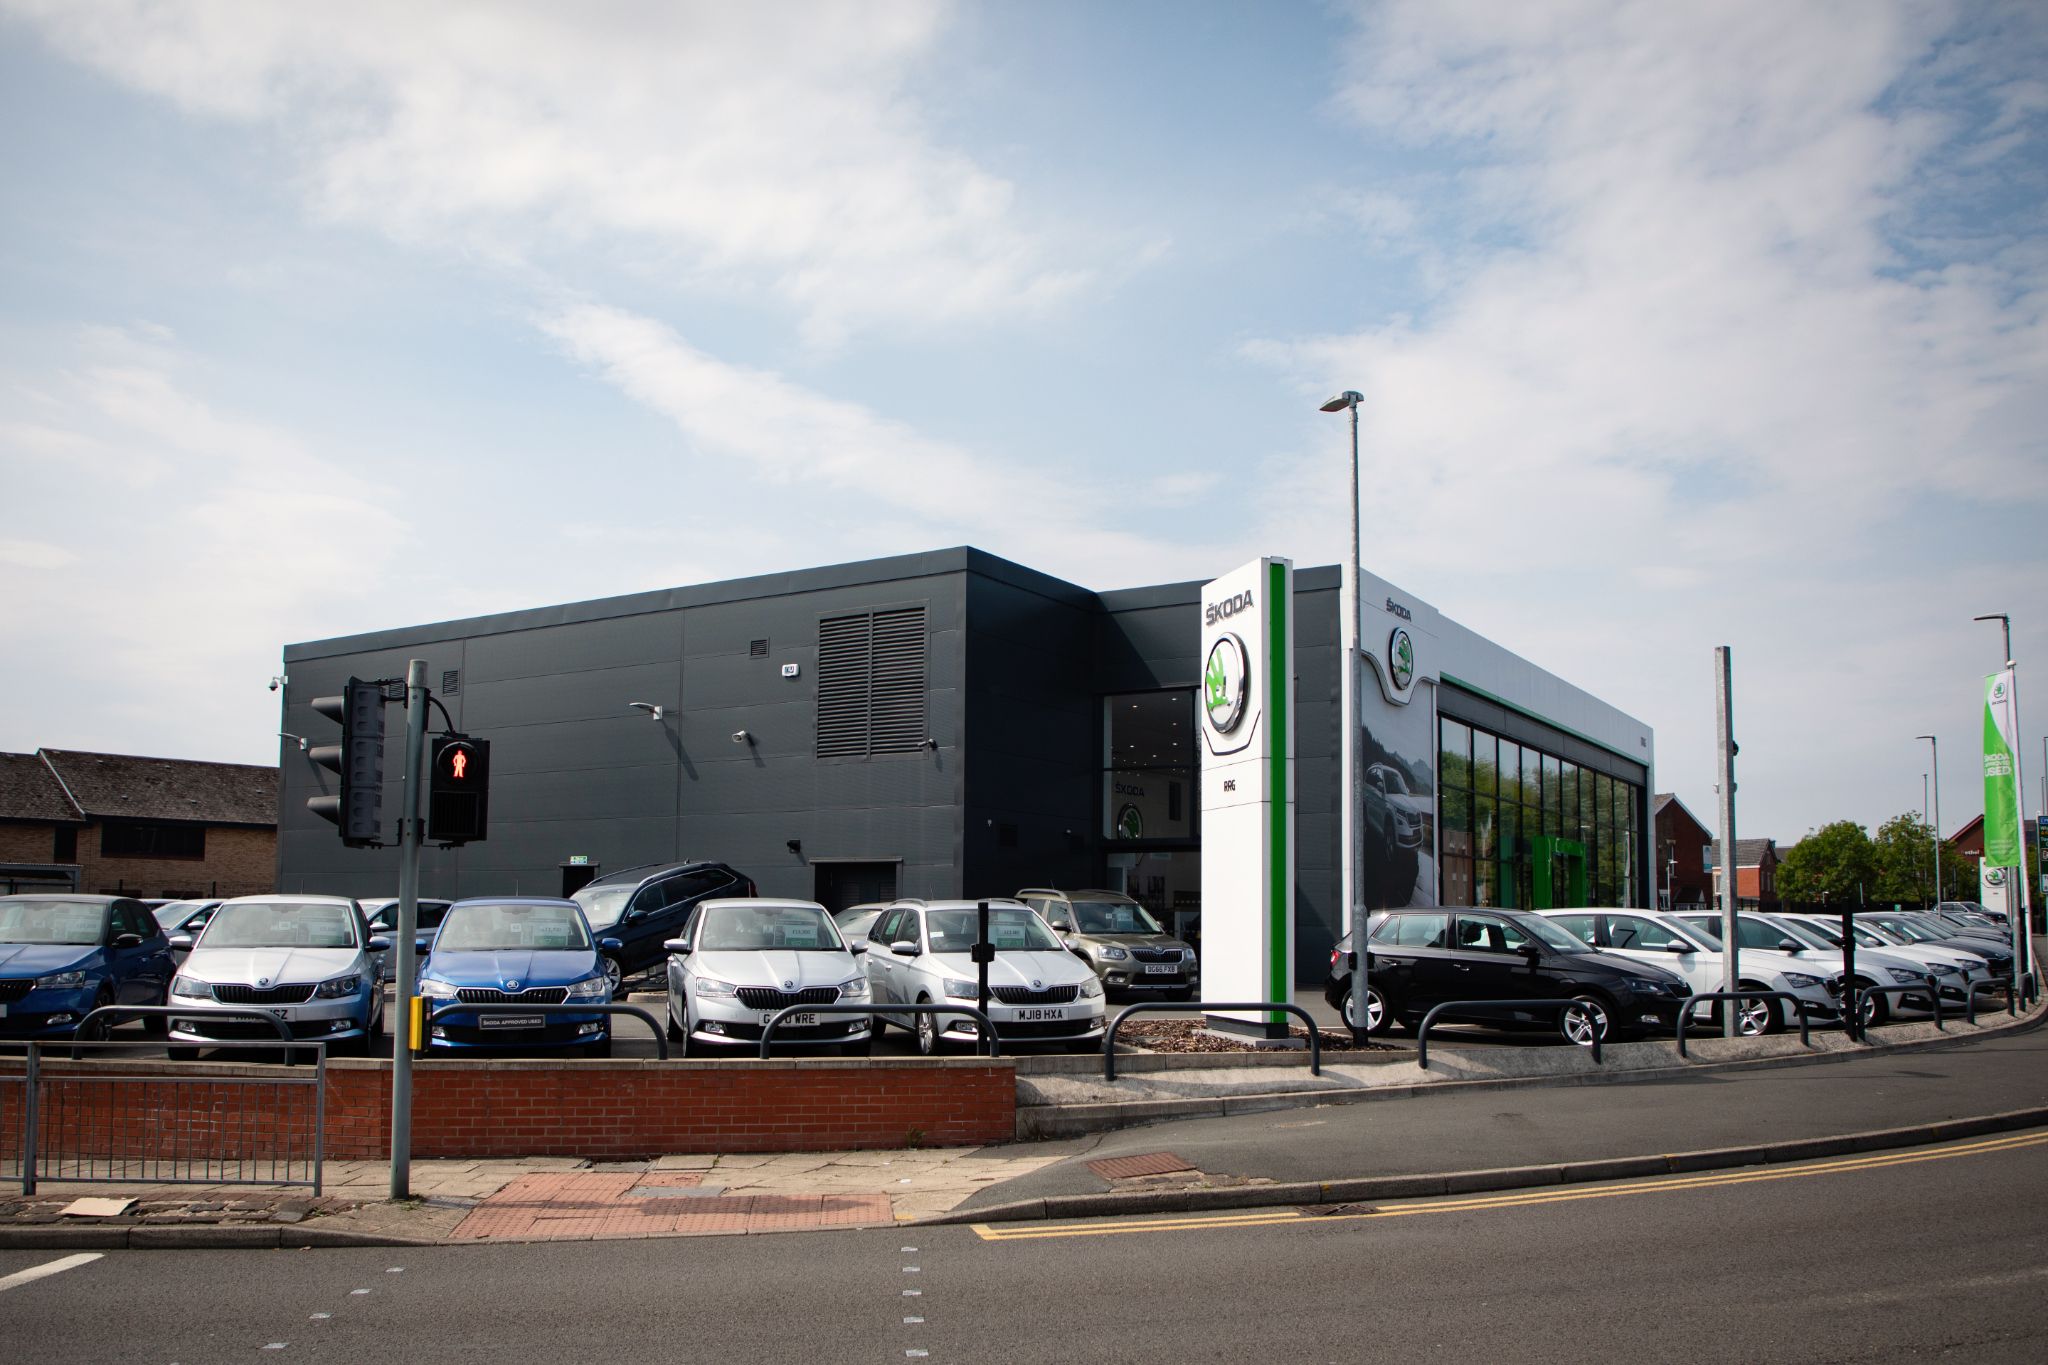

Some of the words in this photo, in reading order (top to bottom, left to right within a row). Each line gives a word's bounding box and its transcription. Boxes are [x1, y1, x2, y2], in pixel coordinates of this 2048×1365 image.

[1206, 590, 1253, 626] ŠKODA
[1386, 597, 1411, 622] ŠKODA
[1985, 766, 2011, 777] USED
[795, 1013, 816, 1024] WRE
[1019, 1009, 1042, 1020] MJ18
[1044, 1009, 1063, 1020] HXA
